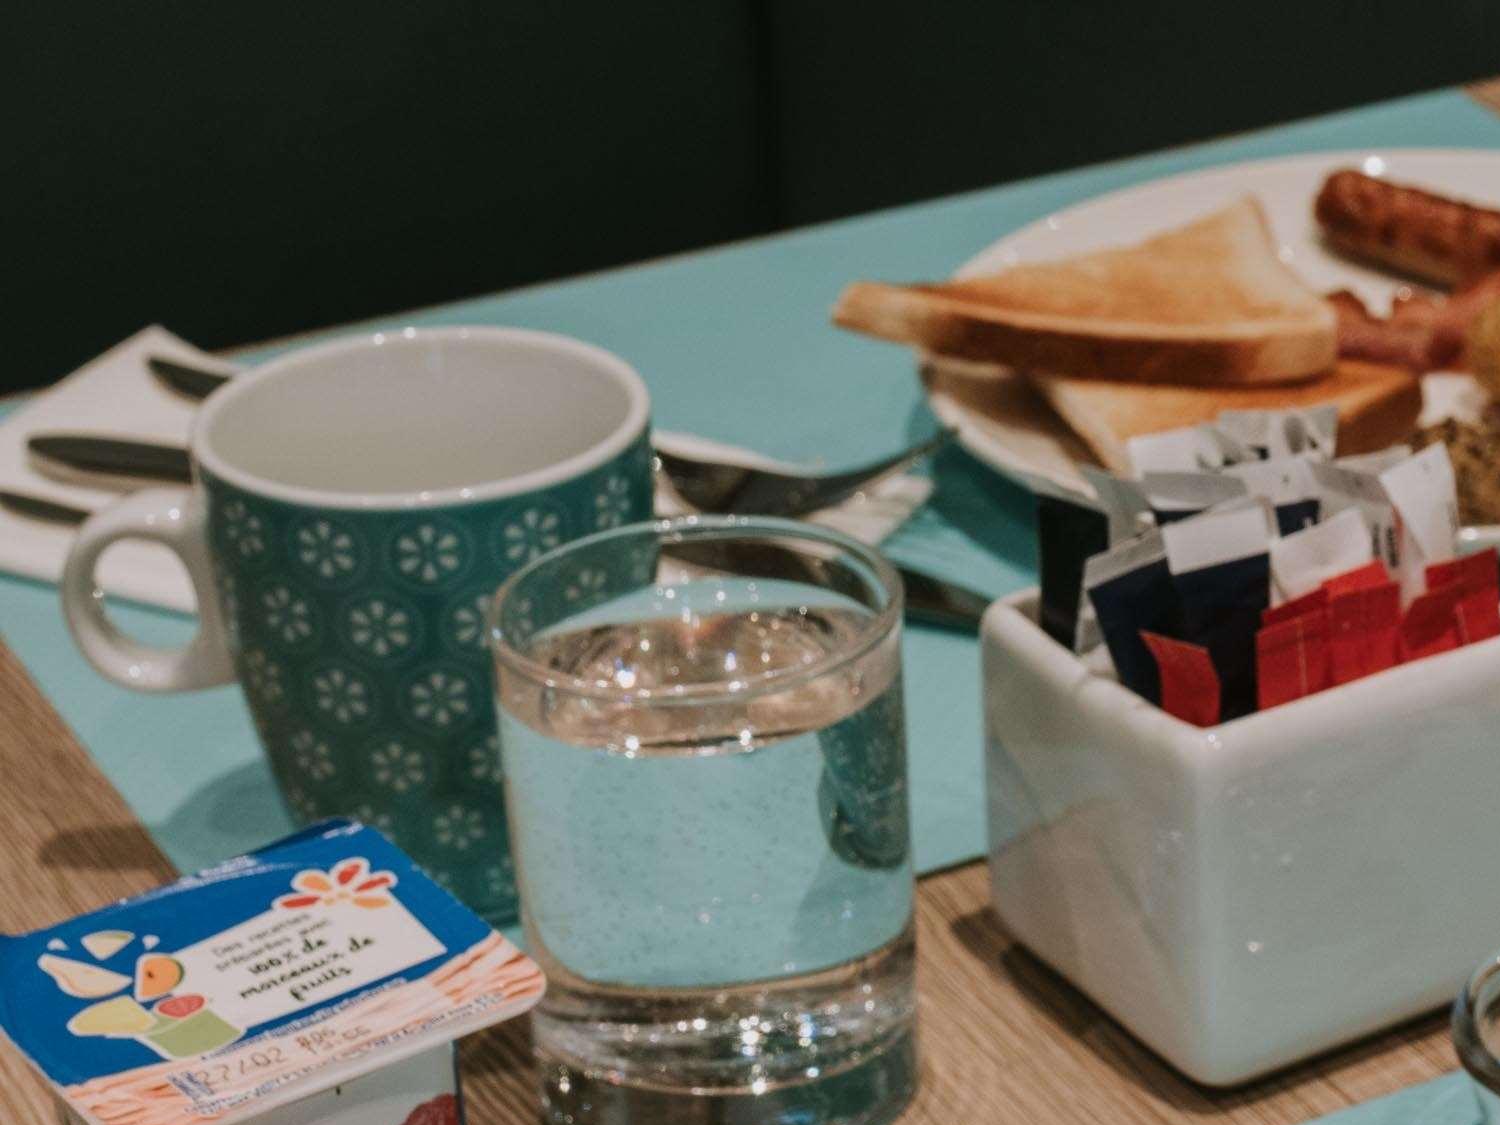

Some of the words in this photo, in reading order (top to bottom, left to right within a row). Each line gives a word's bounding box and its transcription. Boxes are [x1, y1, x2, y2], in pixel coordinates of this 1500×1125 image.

[240, 952, 344, 999] morceaux
[349, 937, 375, 953] de
[289, 967, 352, 1002] fruits
